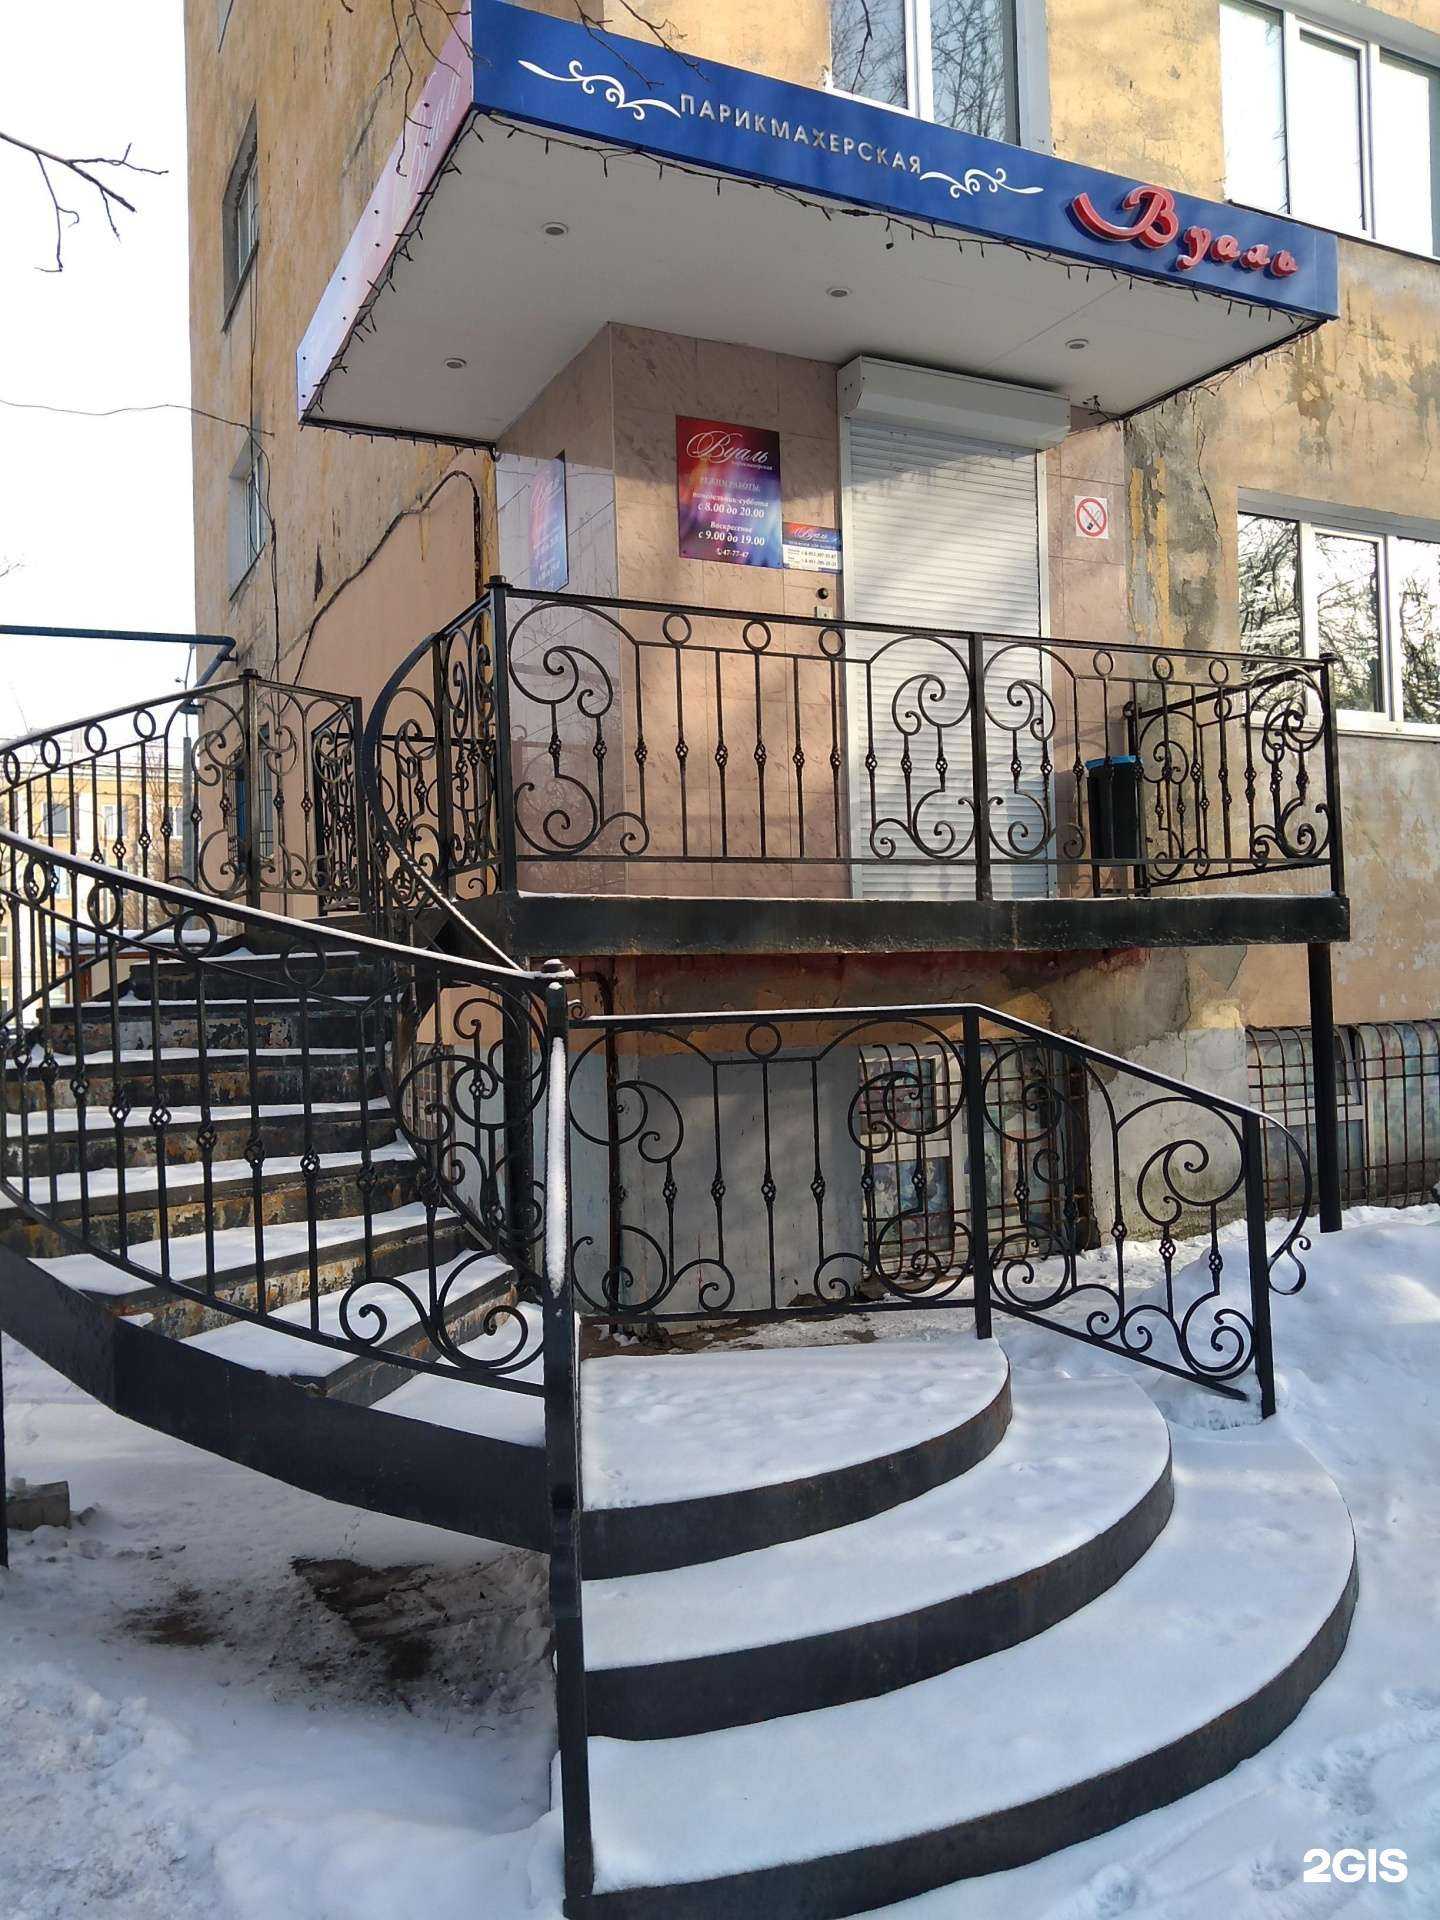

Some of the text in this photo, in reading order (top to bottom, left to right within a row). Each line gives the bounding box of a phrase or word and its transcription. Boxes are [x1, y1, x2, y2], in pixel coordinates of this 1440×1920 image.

[679, 93, 922, 175] ПАРИКМАХЕРСКАЯ
[686, 430, 769, 464] Вуаль
[704, 502, 725, 513] 8.00
[726, 505, 738, 515] до
[739, 506, 765, 519] 20.00
[705, 530, 726, 541] 9.00
[726, 532, 738, 543] до
[741, 535, 766, 546] 19.00
